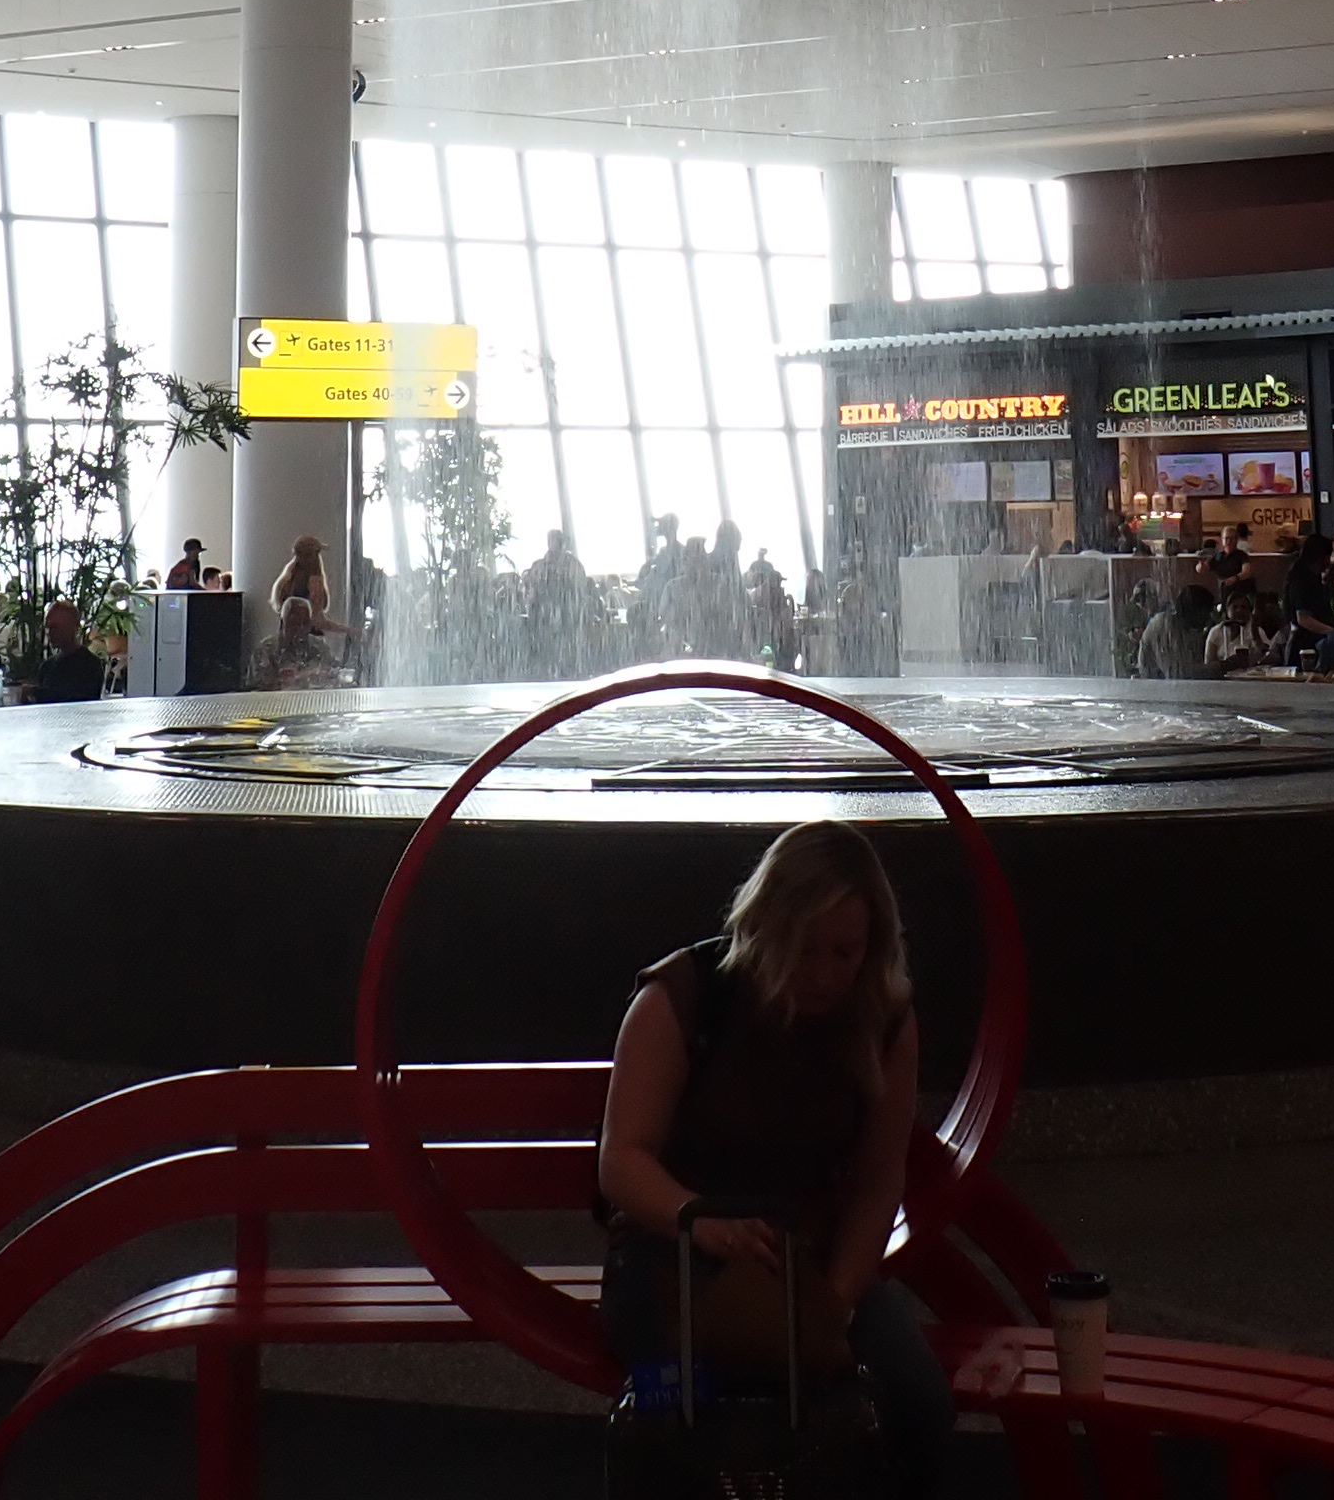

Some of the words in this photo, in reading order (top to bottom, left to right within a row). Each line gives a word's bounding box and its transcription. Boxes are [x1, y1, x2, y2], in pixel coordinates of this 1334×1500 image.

[307, 336, 351, 353] Gates
[355, 337, 394, 353] 11-31
[325, 386, 368, 402] Gates
[1113, 384, 1201, 413] GREEN
[840, 402, 901, 426] HILL
[924, 395, 1066, 422] COUNTRY
[839, 430, 889, 445] BARBECUE
[898, 425, 968, 440] SANDWICHES
[978, 424, 1012, 438] FRIED
[1014, 422, 1065, 437] CHICKEN
[1096, 420, 1145, 434] SALADS
[1151, 416, 1222, 433] SMOOTHIES
[1227, 413, 1307, 429] SANDWICHES
[1252, 508, 1303, 525] GREEN
